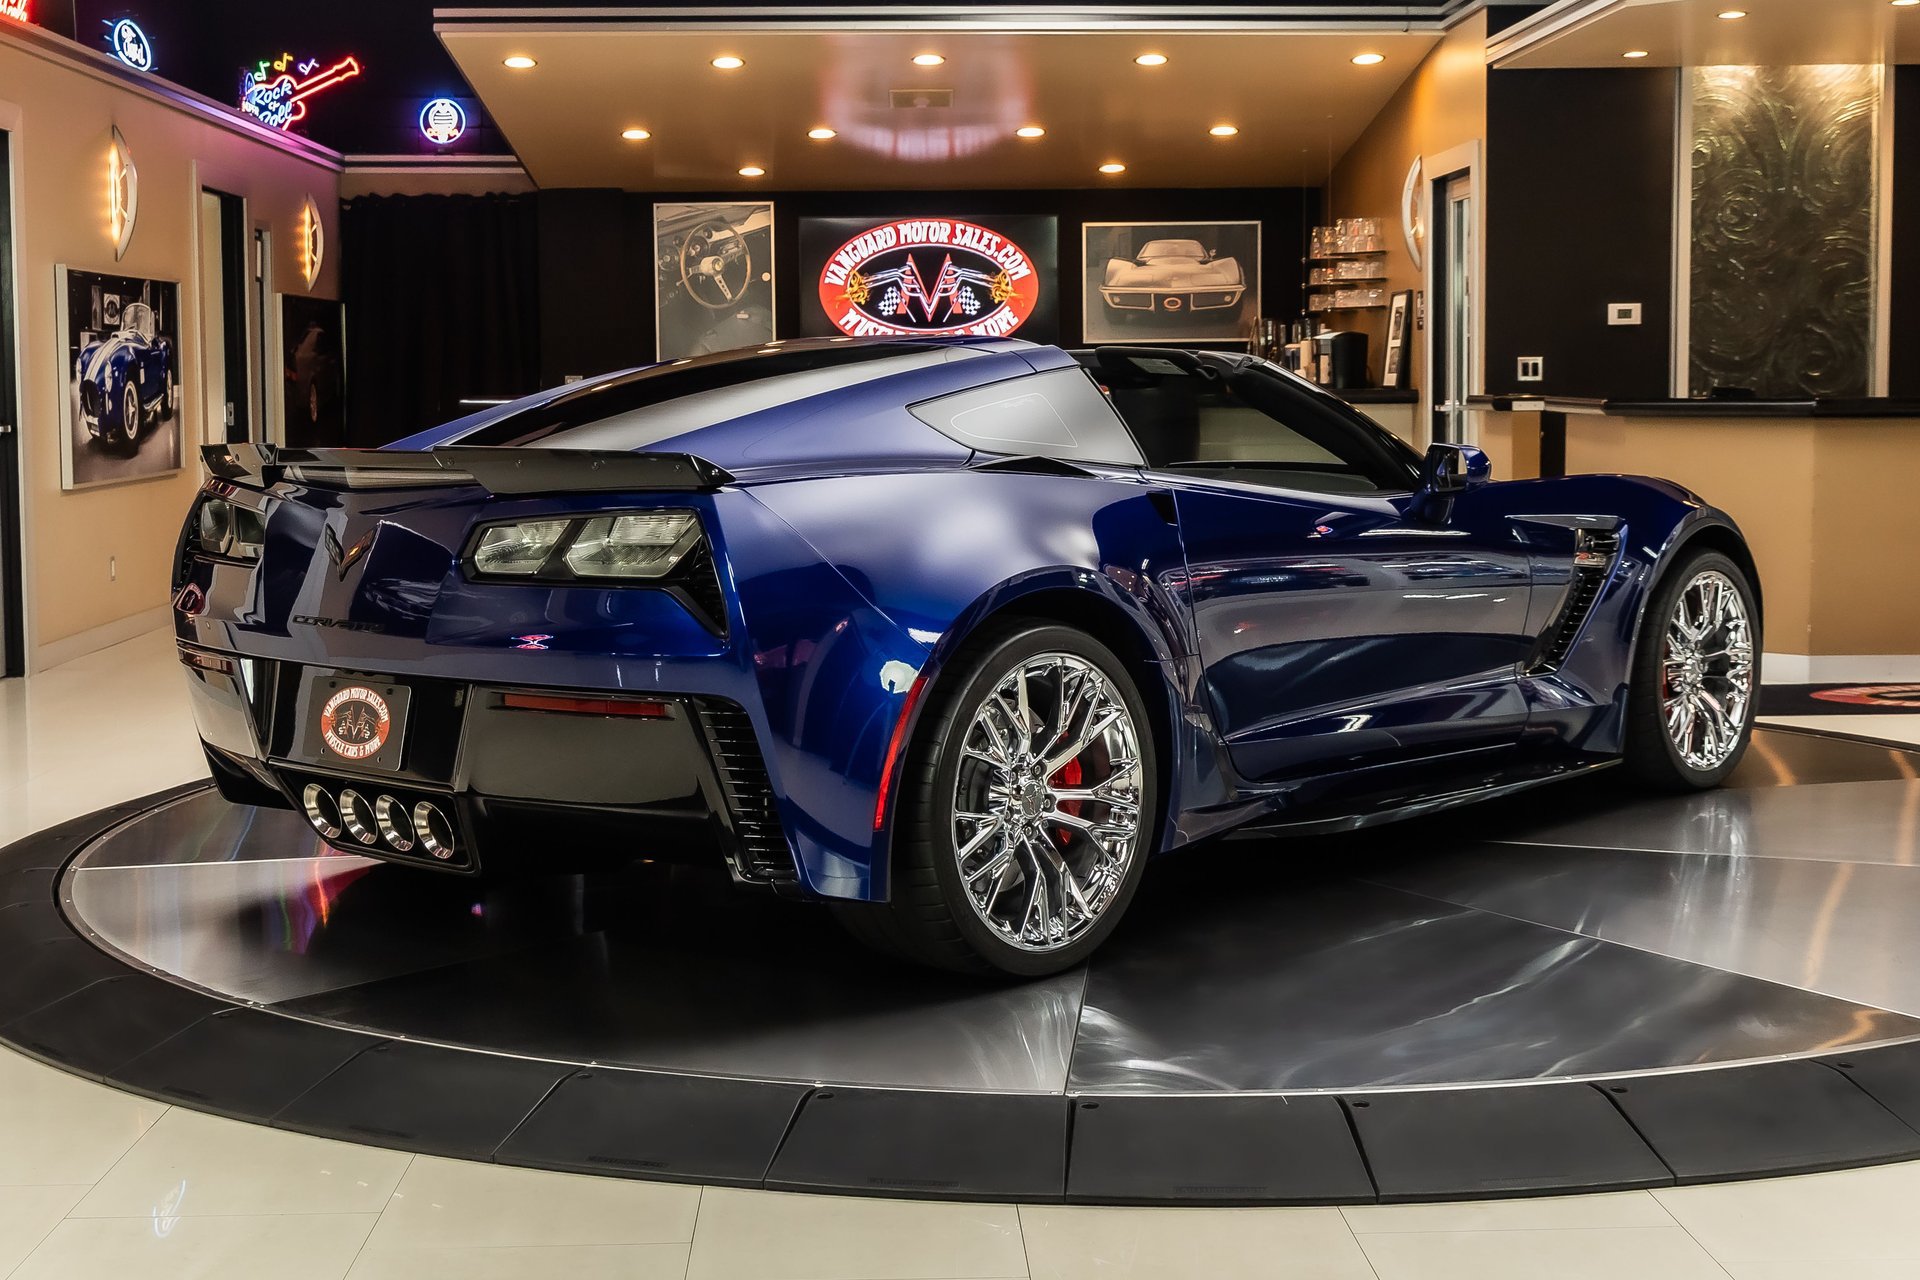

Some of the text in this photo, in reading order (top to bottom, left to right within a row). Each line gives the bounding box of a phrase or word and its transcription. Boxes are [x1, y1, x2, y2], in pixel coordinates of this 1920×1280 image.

[252, 78, 292, 106] Rock
[824, 221, 1031, 286] VANGUARD MOTOR SALES.COM
